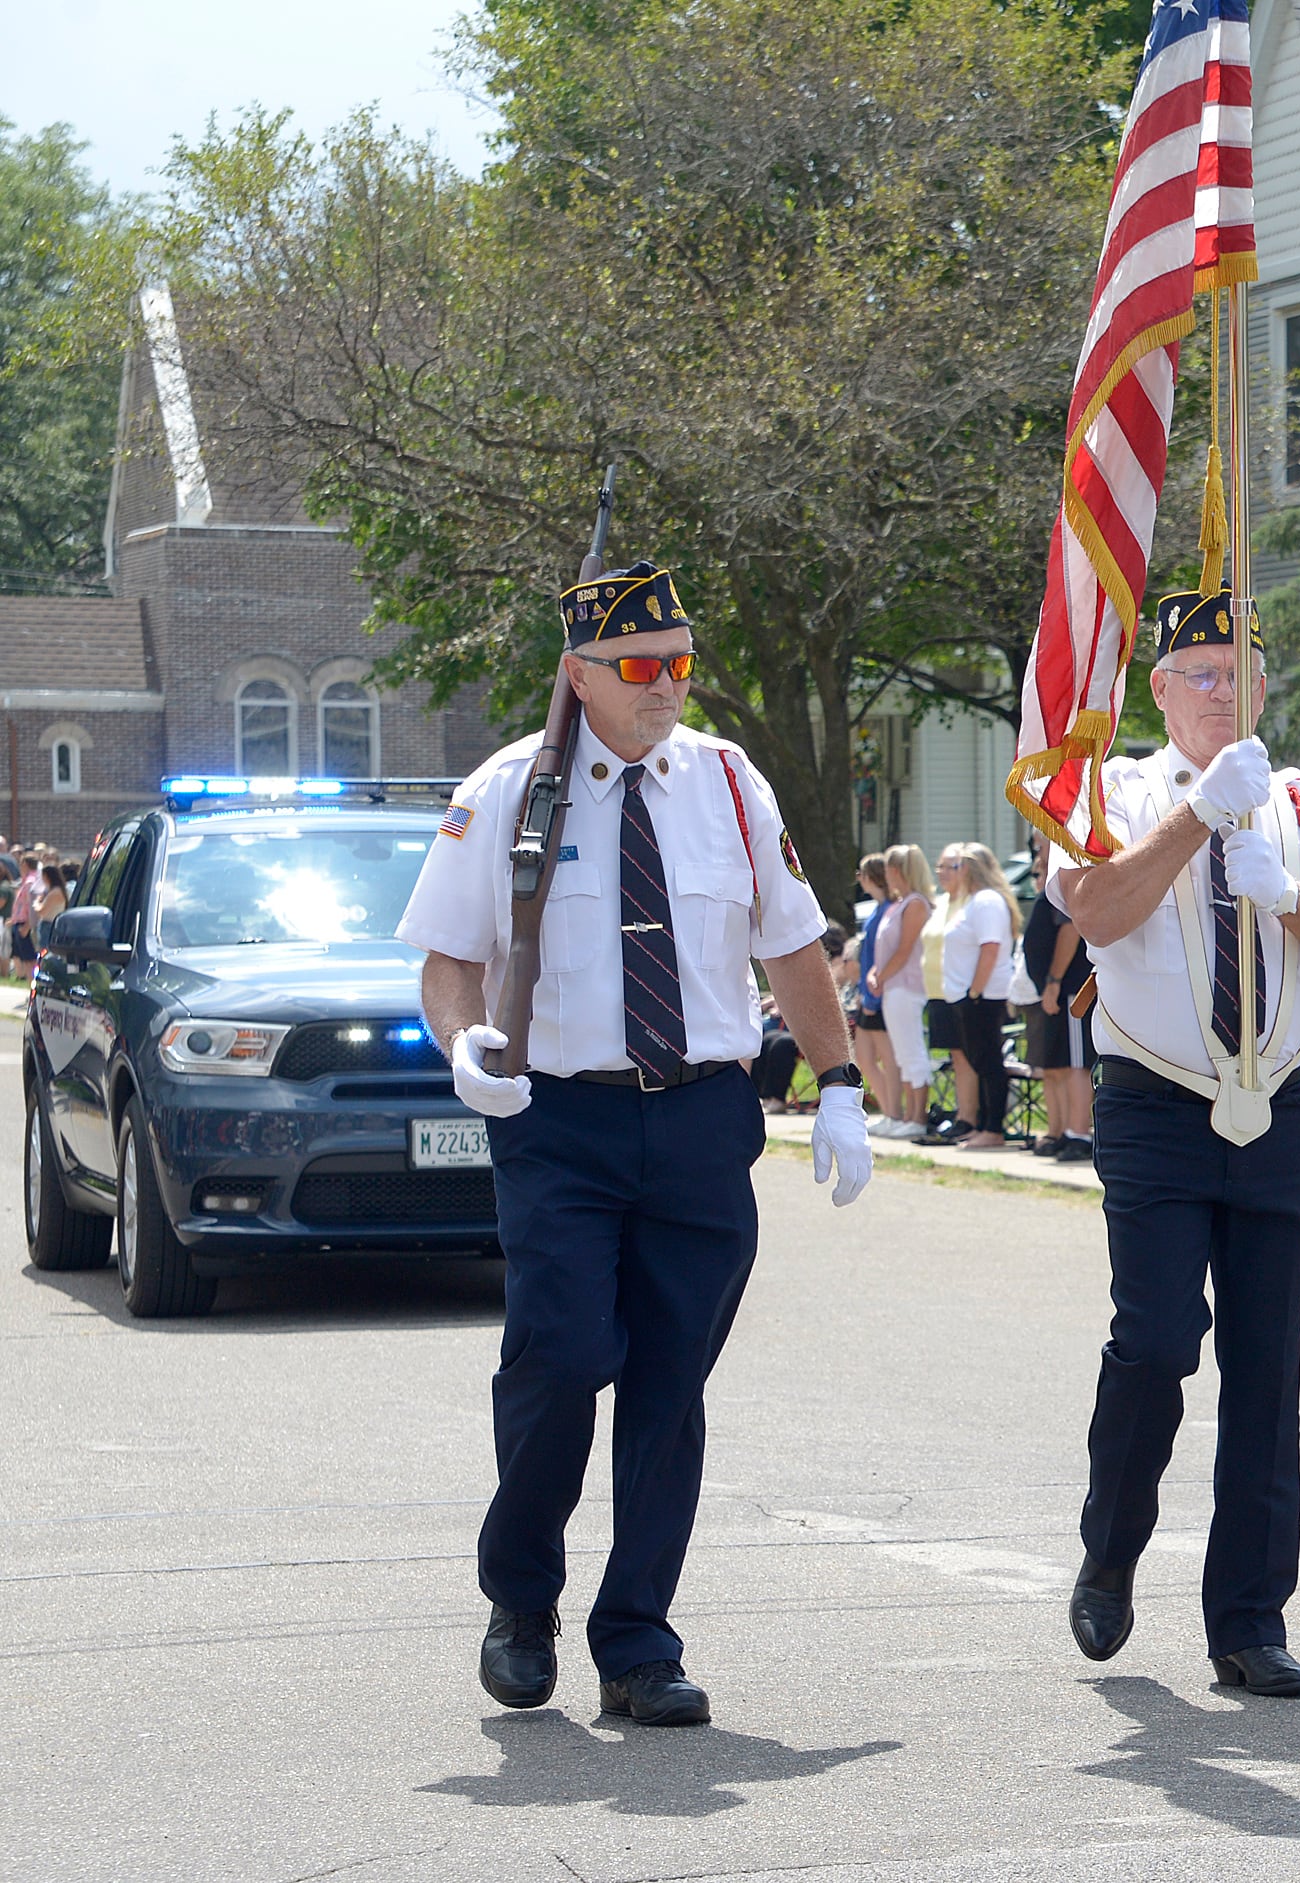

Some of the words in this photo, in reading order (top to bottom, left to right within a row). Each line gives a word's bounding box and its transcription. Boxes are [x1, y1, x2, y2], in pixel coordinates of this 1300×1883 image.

[621, 621, 637, 634] 33
[1192, 632, 1206, 642] 33
[421, 1132, 431, 1155] M
[437, 1131, 491, 1155] 22439
